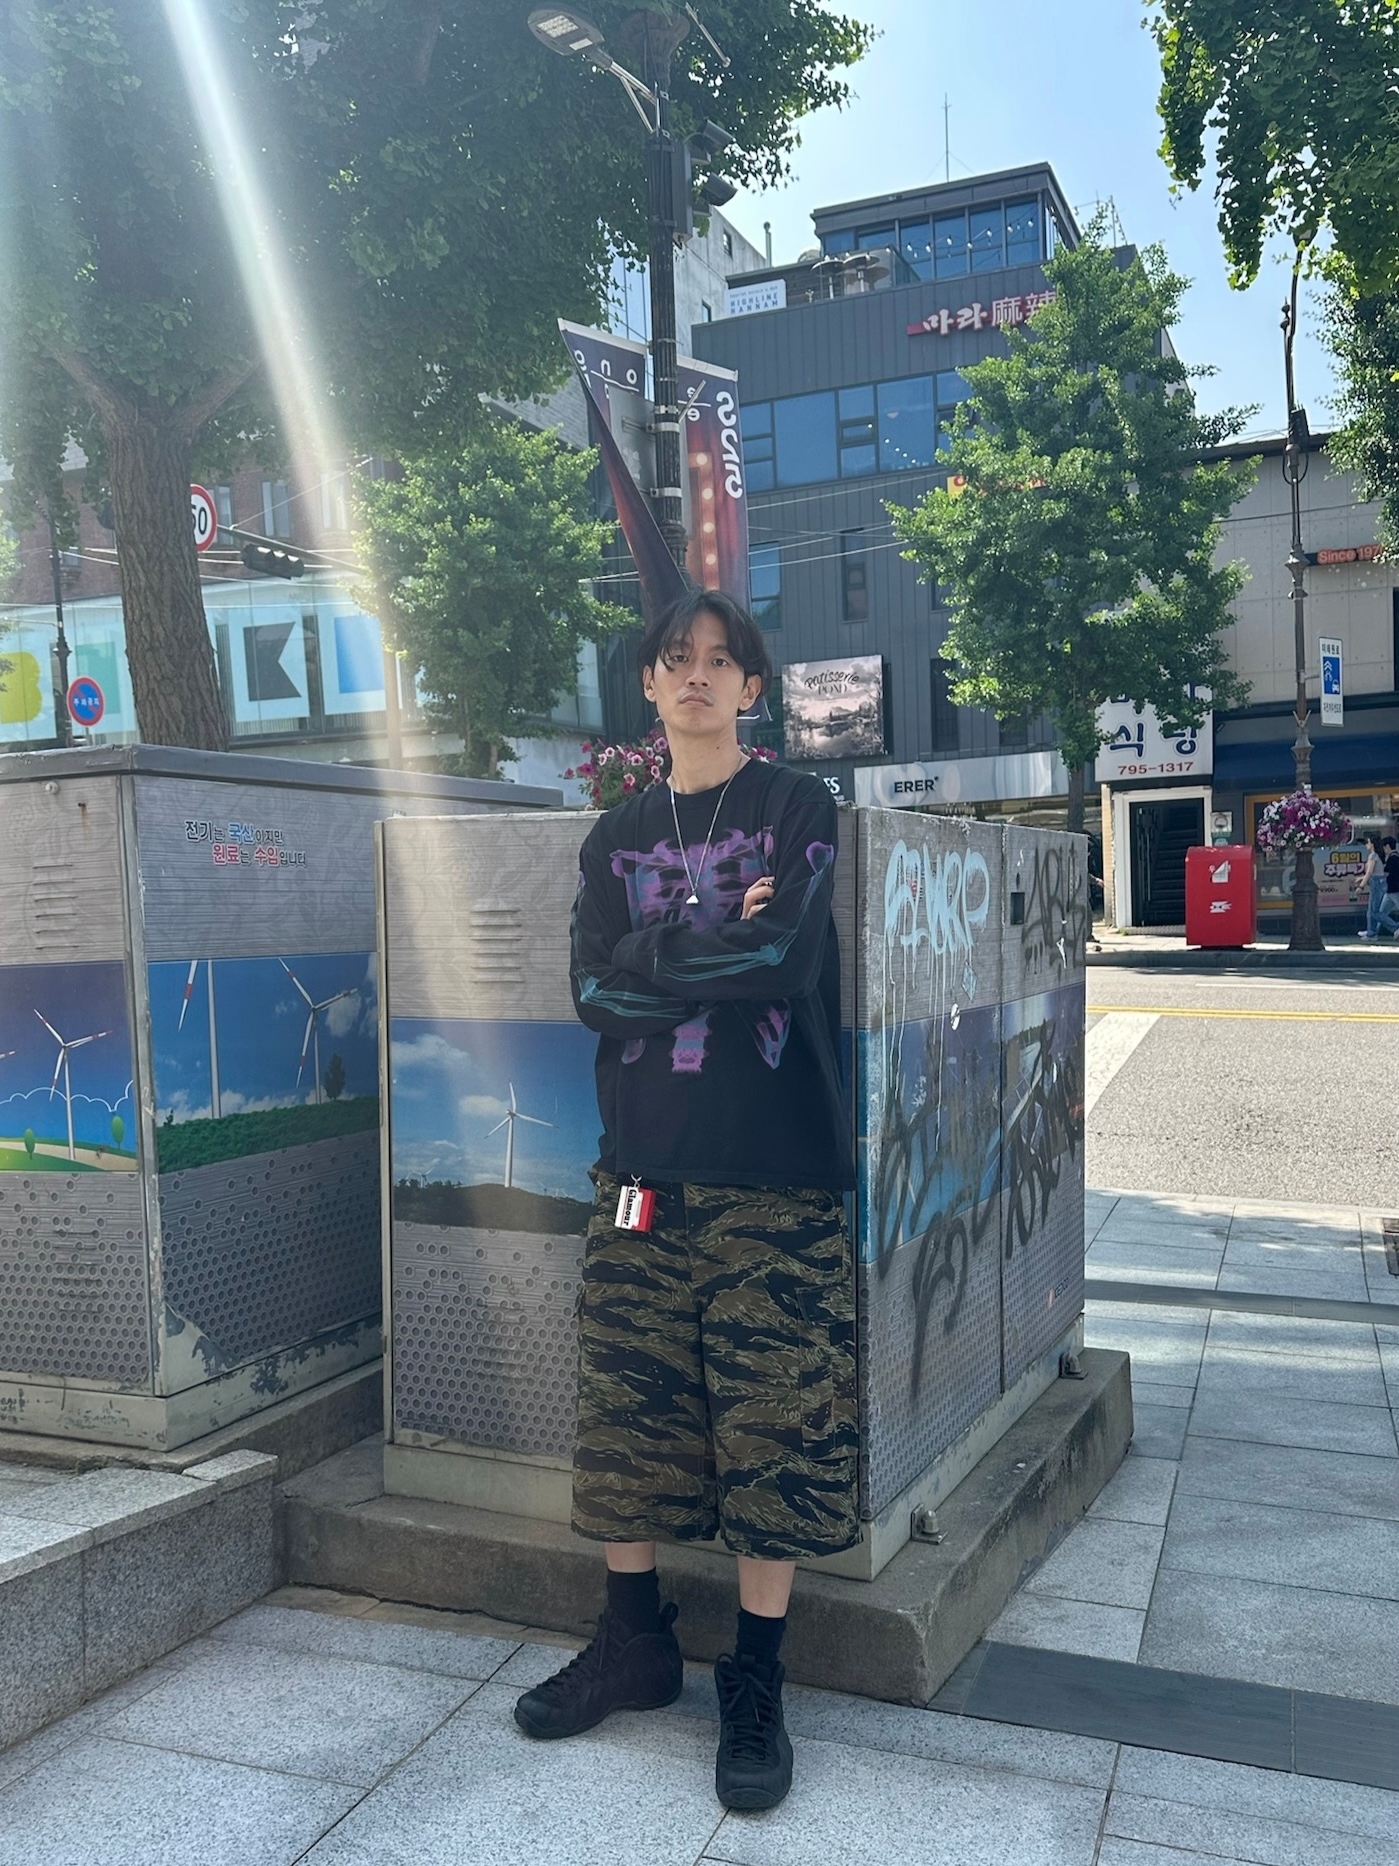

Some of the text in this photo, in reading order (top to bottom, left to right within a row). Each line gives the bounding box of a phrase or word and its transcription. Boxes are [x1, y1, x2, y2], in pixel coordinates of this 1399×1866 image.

[730, 300, 778, 314] HANNAM
[1319, 544, 1384, 564] Since 197
[1117, 761, 1195, 776] 795-1317
[185, 820, 285, 846] 전기는 국산이지만
[212, 844, 308, 868] 원료는 수입입니다
